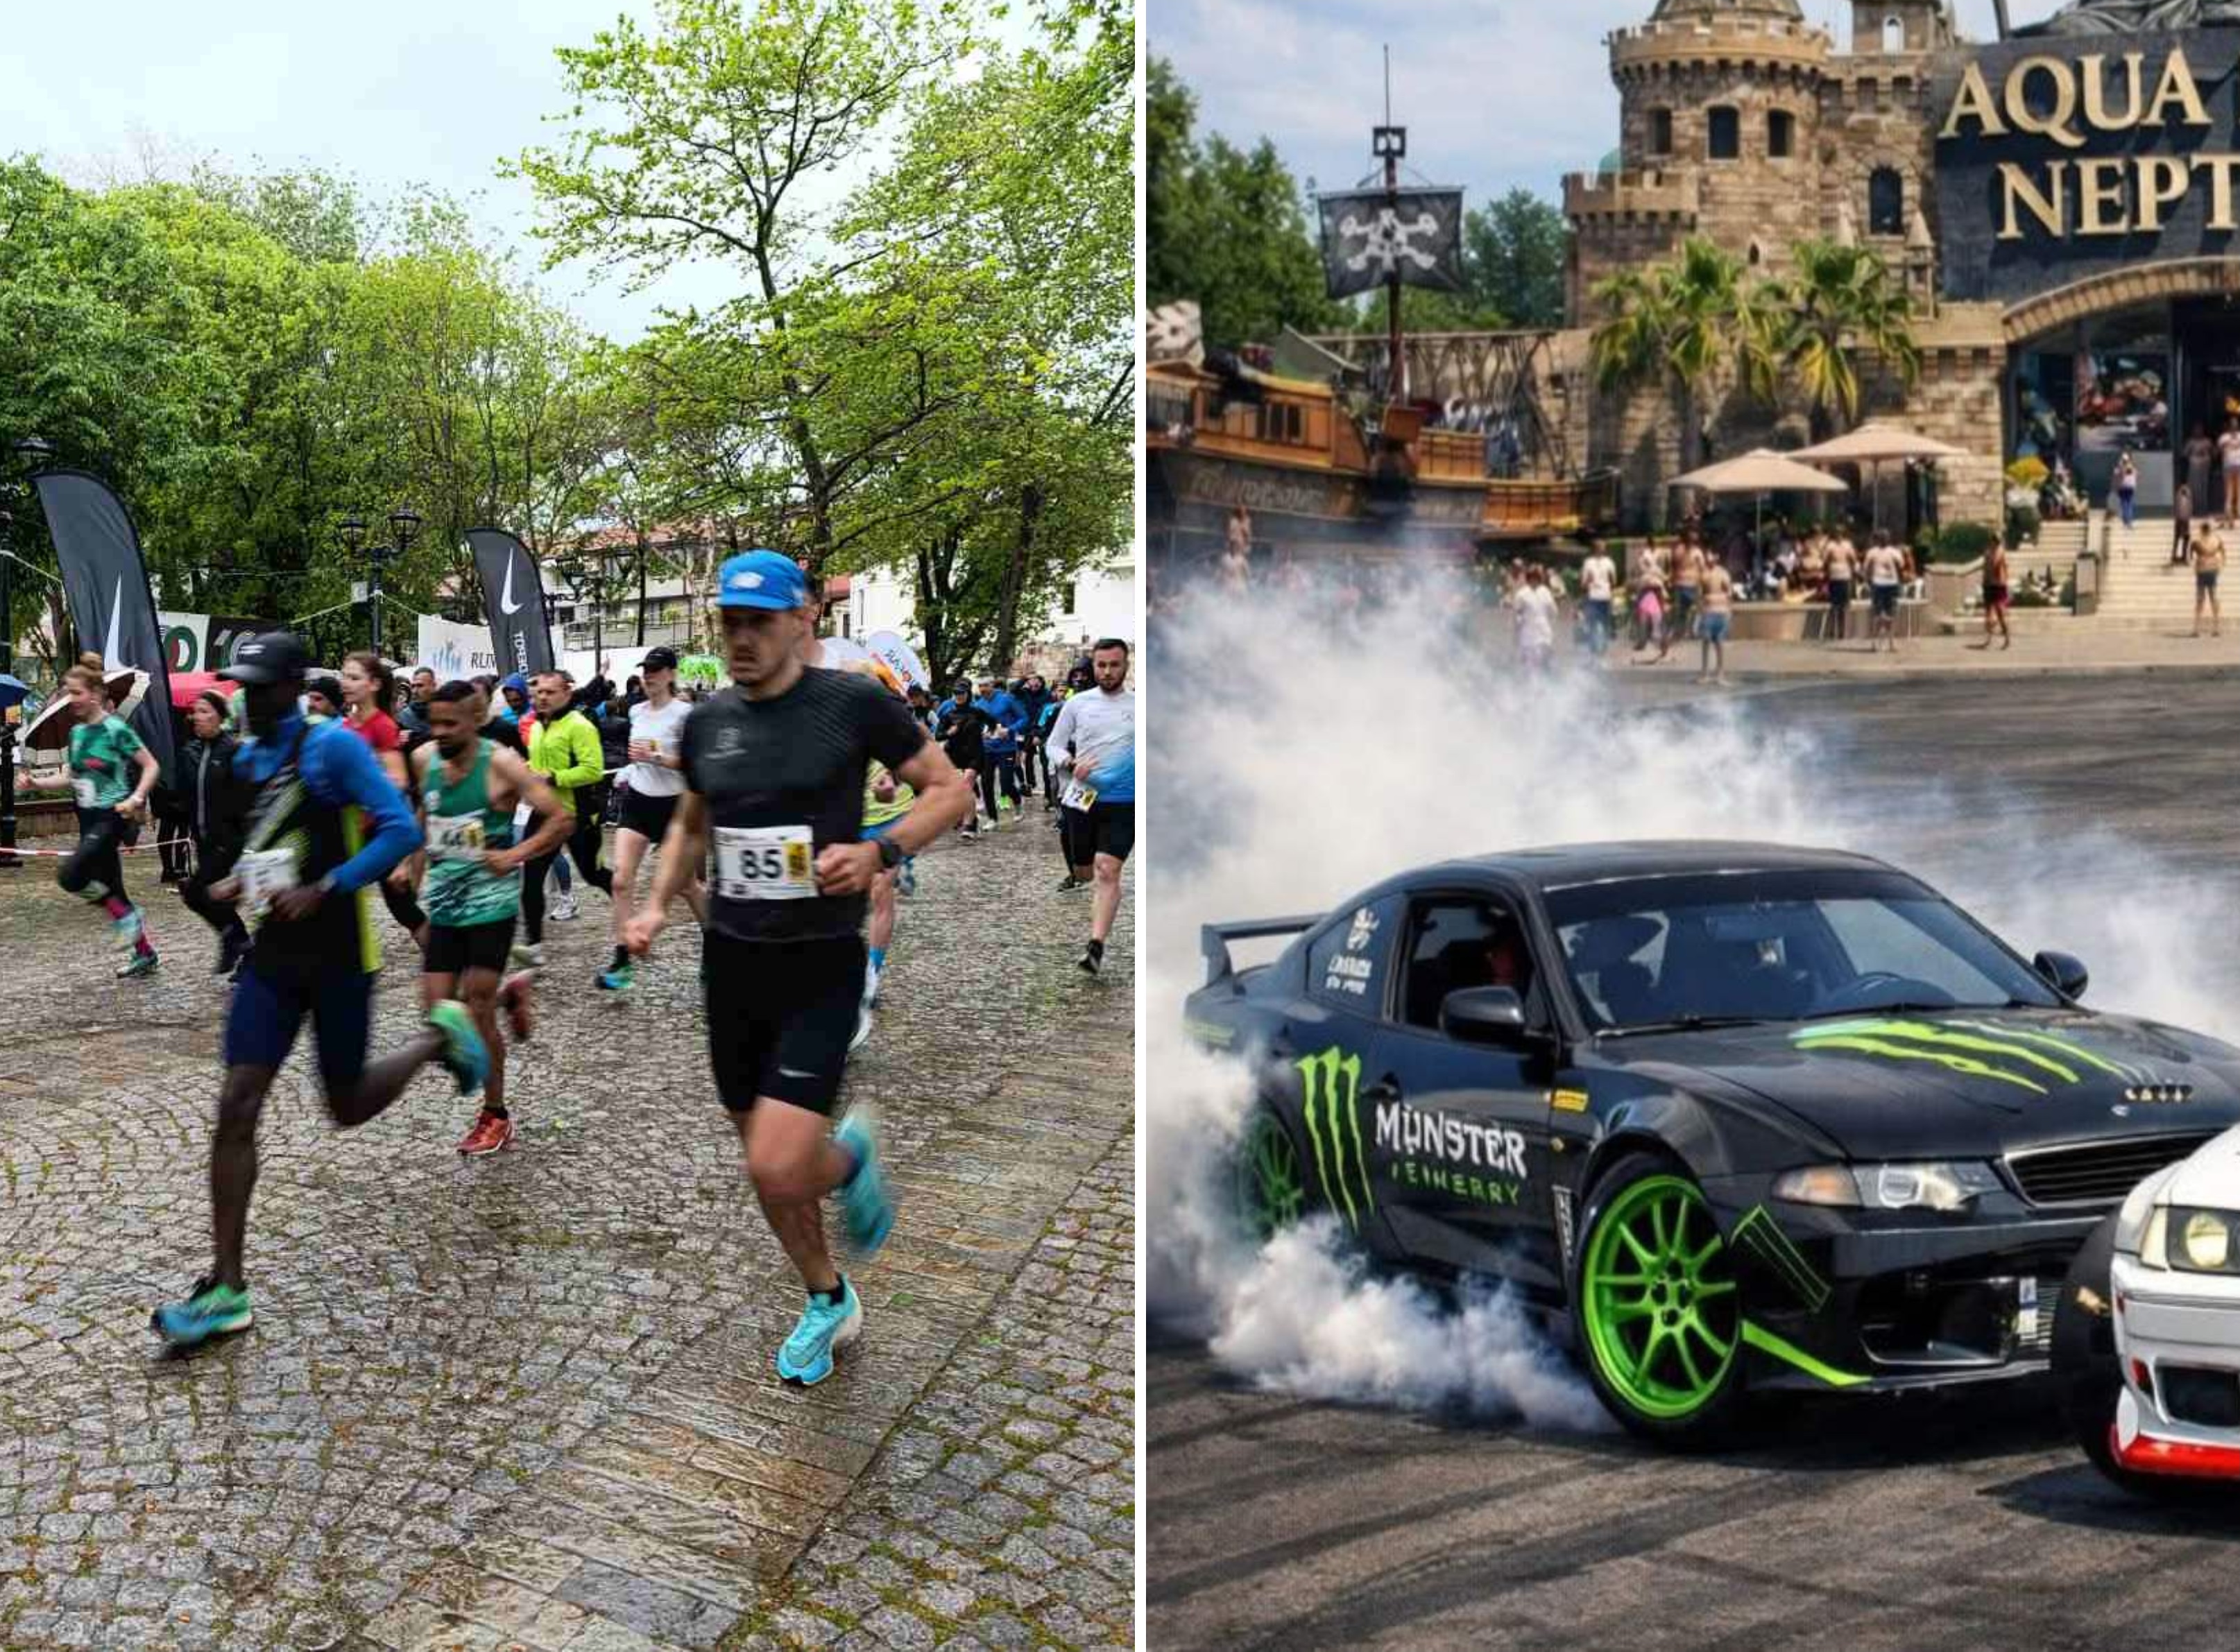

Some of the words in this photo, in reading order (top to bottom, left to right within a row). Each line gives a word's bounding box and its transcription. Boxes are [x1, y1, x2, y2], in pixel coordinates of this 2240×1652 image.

[1938, 46, 2214, 148] AQUA
[1997, 153, 2240, 239] NEPT
[739, 848, 783, 879] 85
